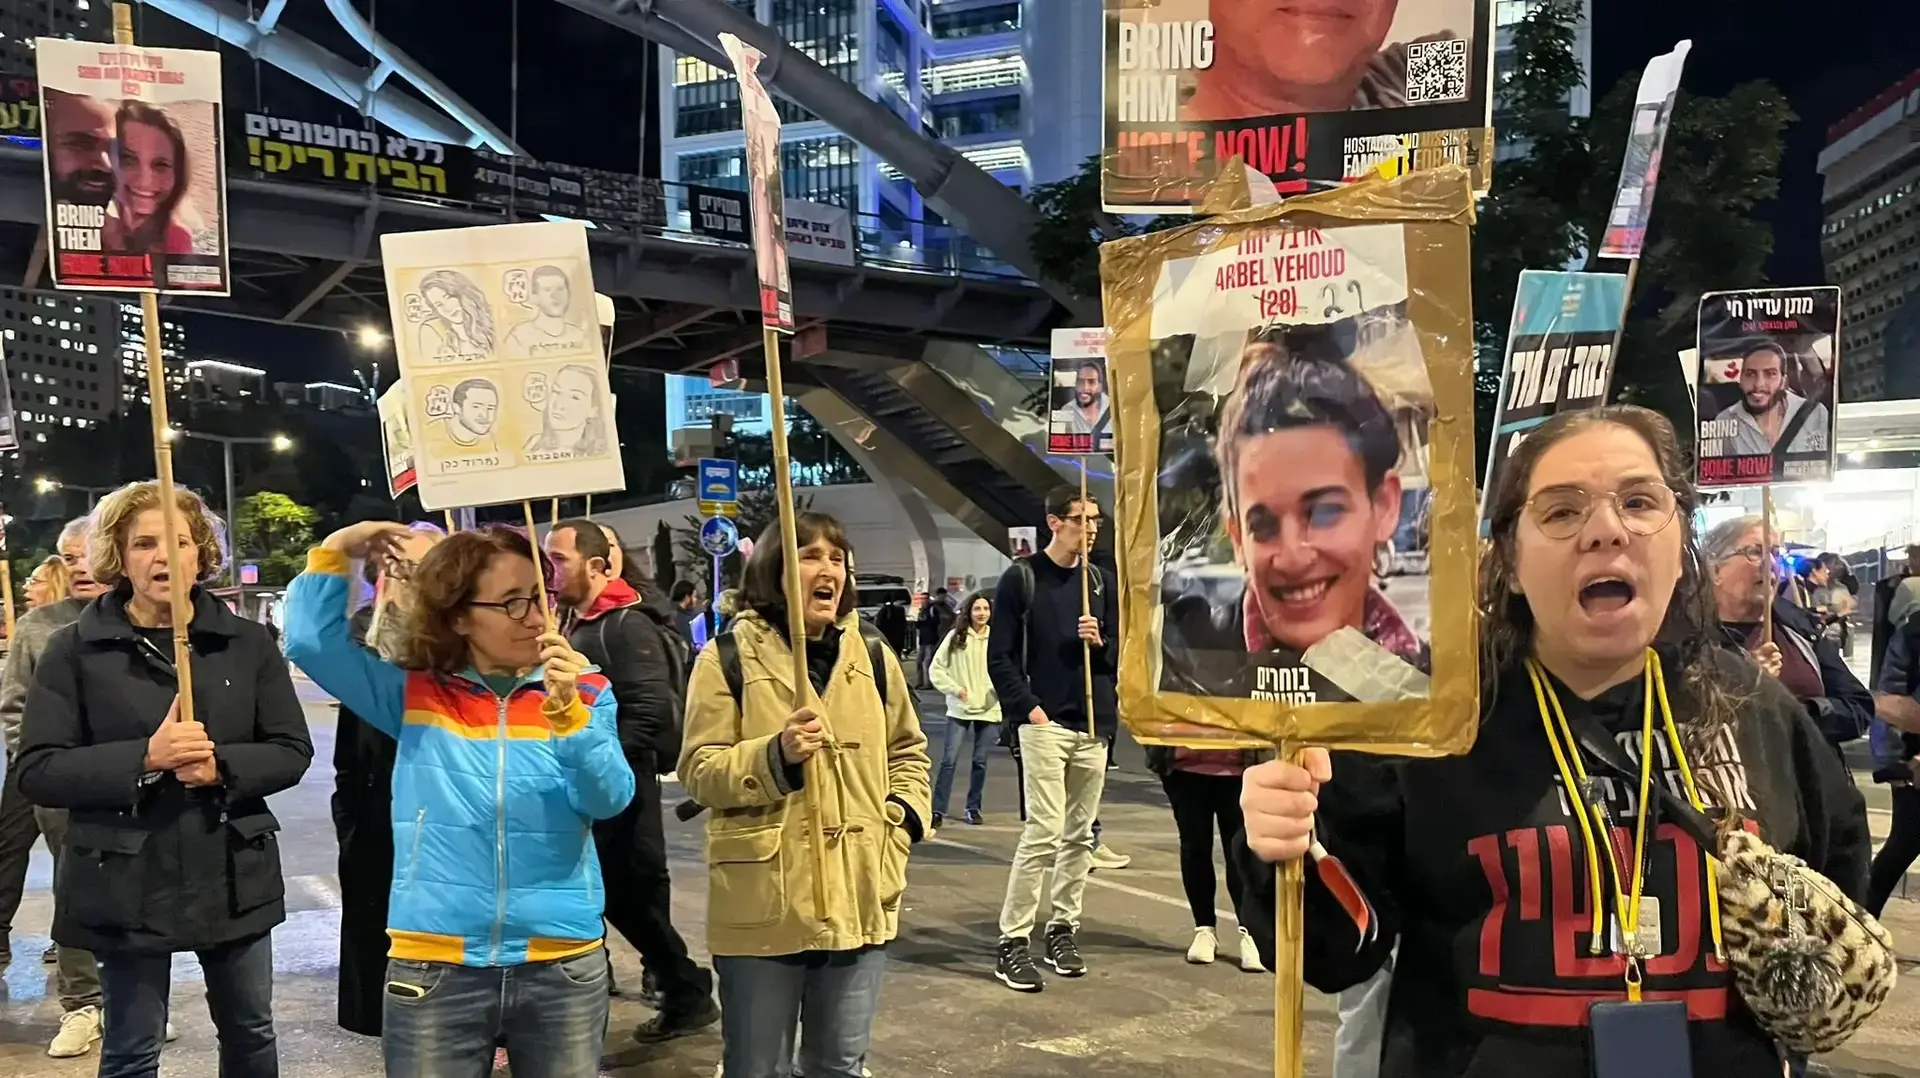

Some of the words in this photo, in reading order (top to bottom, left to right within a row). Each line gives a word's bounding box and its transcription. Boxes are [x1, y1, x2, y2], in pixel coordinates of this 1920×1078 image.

[1119, 20, 1214, 70] BRING
[1118, 75, 1176, 122] HIM
[245, 113, 380, 153] החטופים
[1215, 117, 1307, 174] NOW!
[247, 136, 335, 177] ריק!
[386, 135, 445, 164] ללא
[344, 152, 448, 194] הבית
[56, 204, 105, 227] BRING
[57, 227, 101, 250] THEM
[1215, 258, 1268, 291] ARBEL
[1274, 248, 1345, 283] YEHOUD
[1259, 286, 1298, 319] (28)
[1726, 298, 1743, 318] חי
[1747, 298, 1781, 320] עדיין
[1785, 297, 1814, 319] מתן
[1701, 419, 1738, 439] BRING
[1701, 439, 1724, 457] HIM
[1700, 460, 1734, 477] HOME
[1737, 457, 1774, 476] NOW!
[1257, 666, 1310, 691] בוחרים
